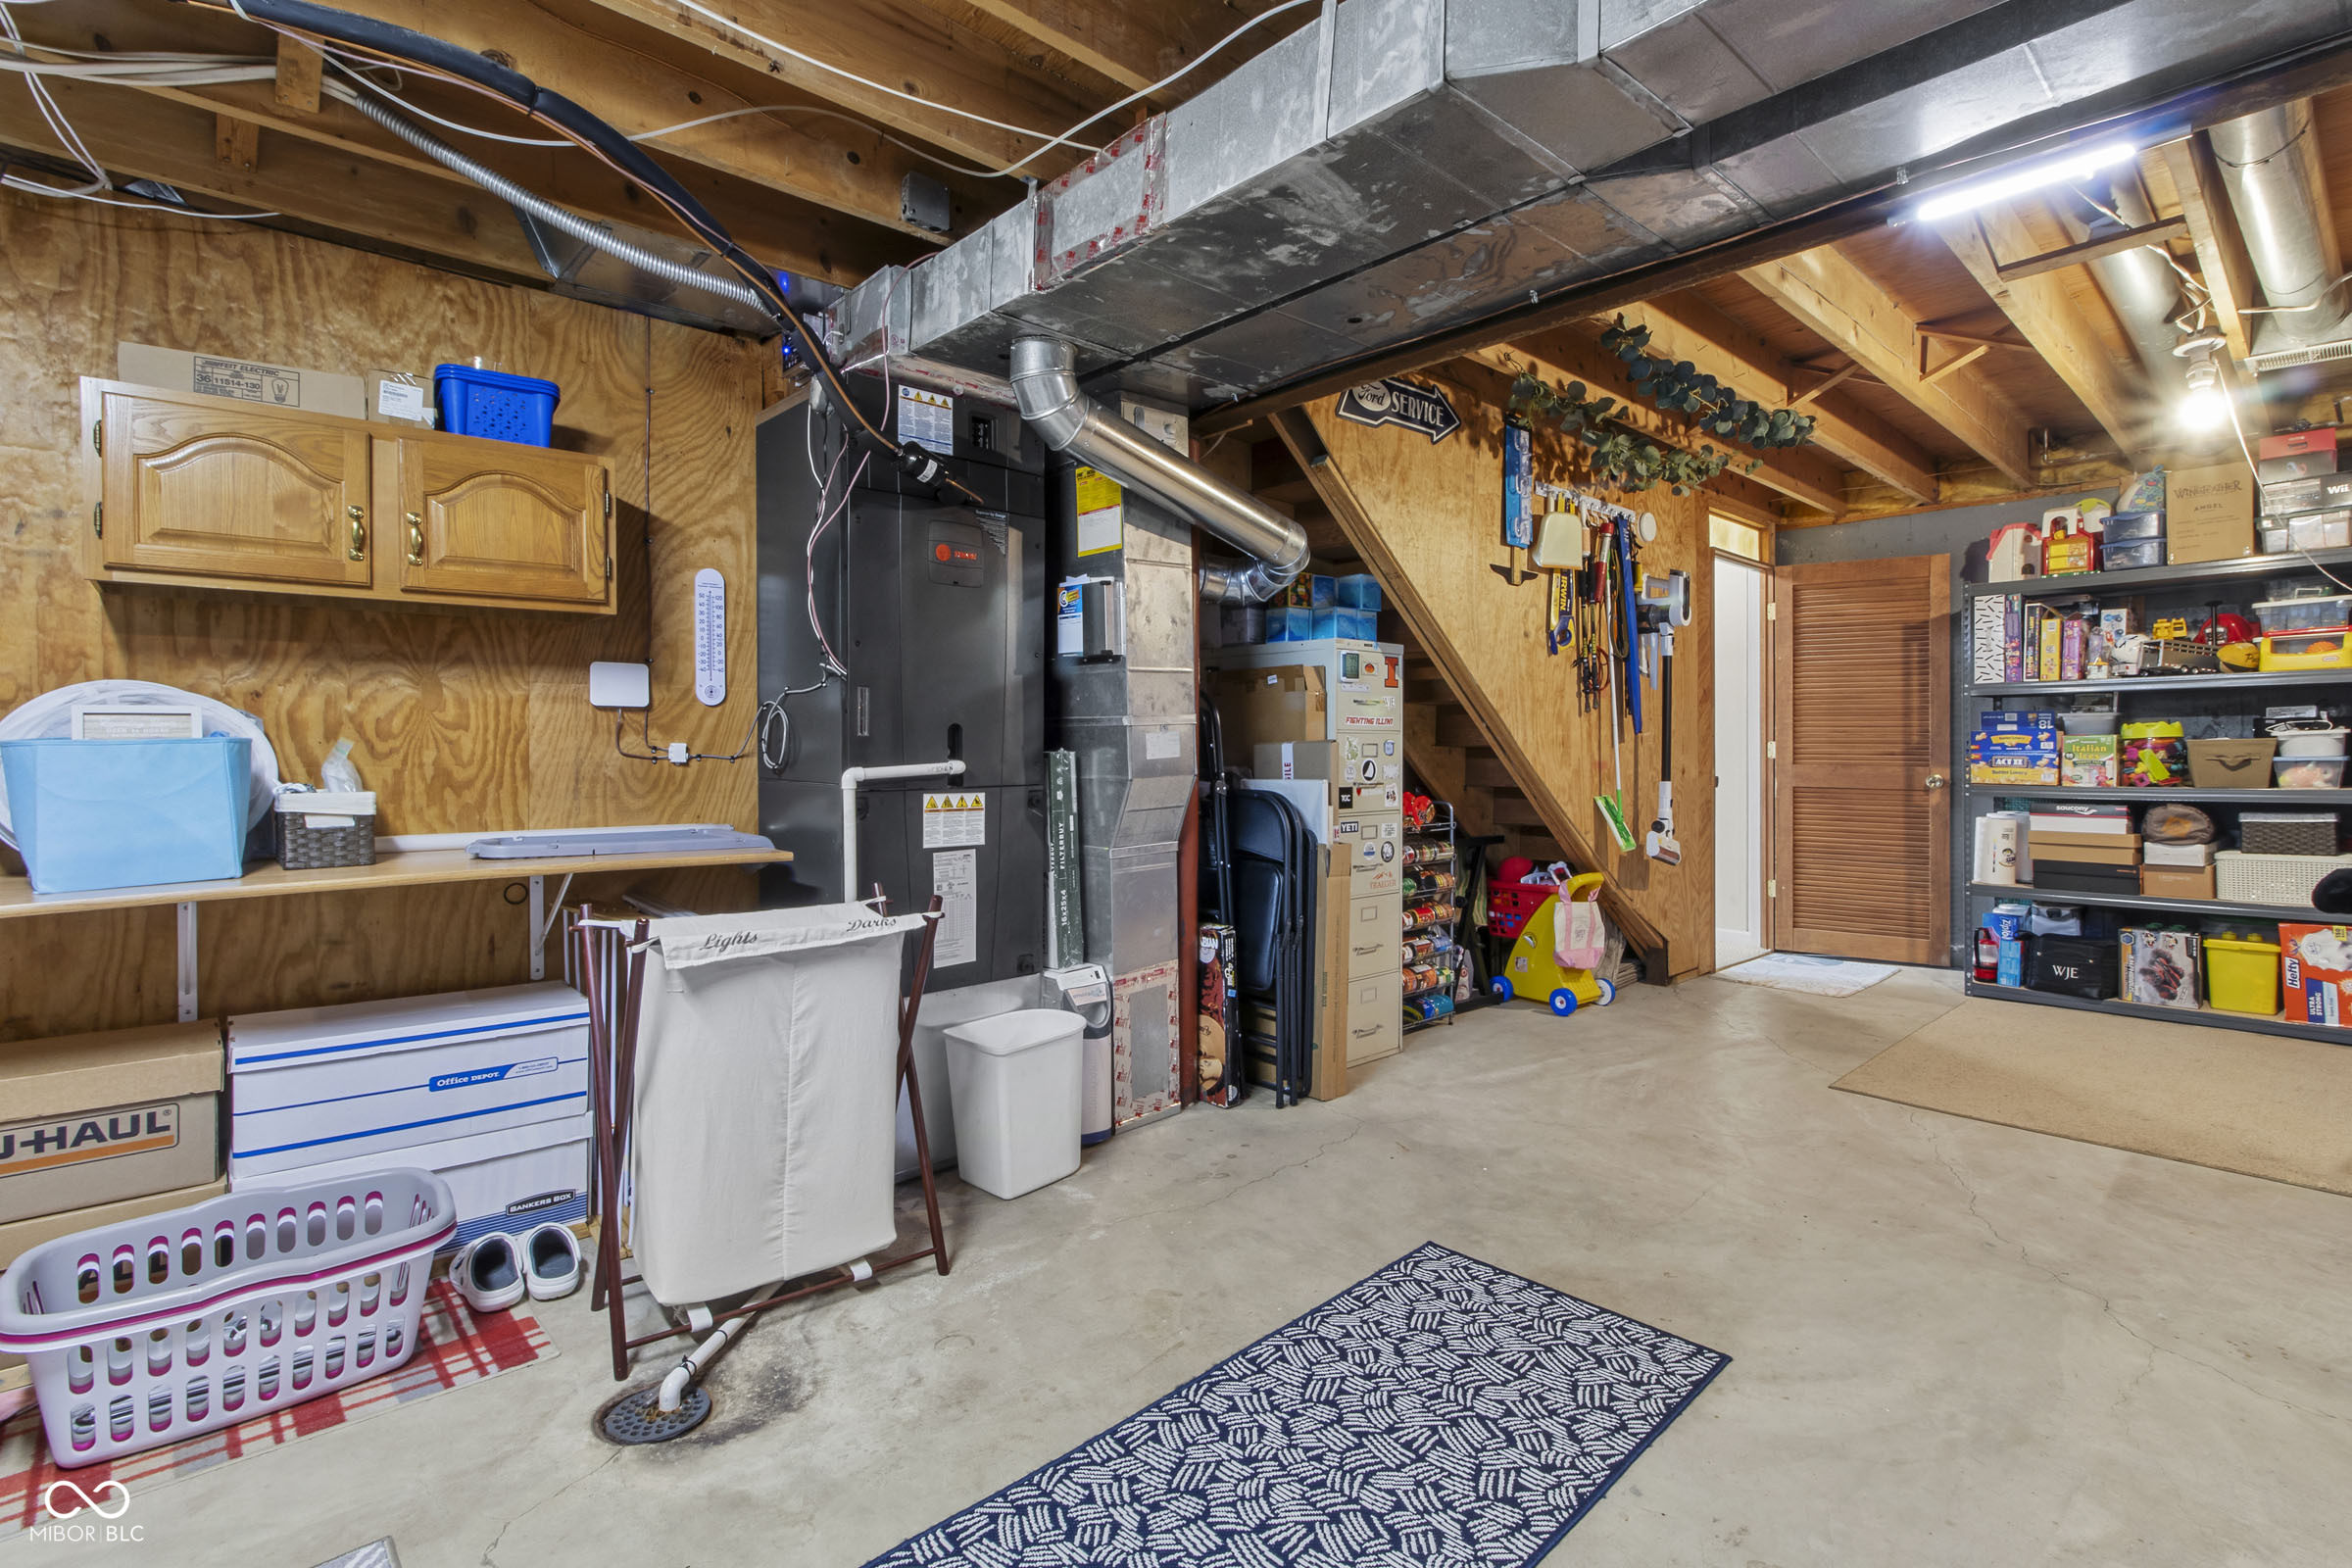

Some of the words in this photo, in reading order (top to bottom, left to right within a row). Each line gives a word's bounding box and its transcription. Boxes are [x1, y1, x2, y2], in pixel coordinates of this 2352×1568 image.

[196, 373, 212, 383] 36
[240, 365, 279, 376] ELECTRIC
[215, 377, 260, 390] 11S14-130
[1358, 383, 1385, 406] Ford
[1392, 391, 1445, 427] SERVICE
[1559, 575, 1568, 611] IRWIN
[1385, 657, 1398, 688] I
[1346, 716, 1374, 725] FIGHTING
[2038, 719, 2054, 729] 18
[2072, 744, 2107, 753] Italian
[1341, 823, 1358, 832] YETI
[847, 917, 897, 932] Darks
[699, 931, 759, 953] Lights
[2052, 964, 2079, 980] WJE
[2288, 959, 2299, 987] Hefty
[436, 1076, 468, 1087] Office
[471, 1072, 500, 1081] DEPOT
[510, 1198, 552, 1212] BANKERS
[553, 1193, 571, 1202] BOX
